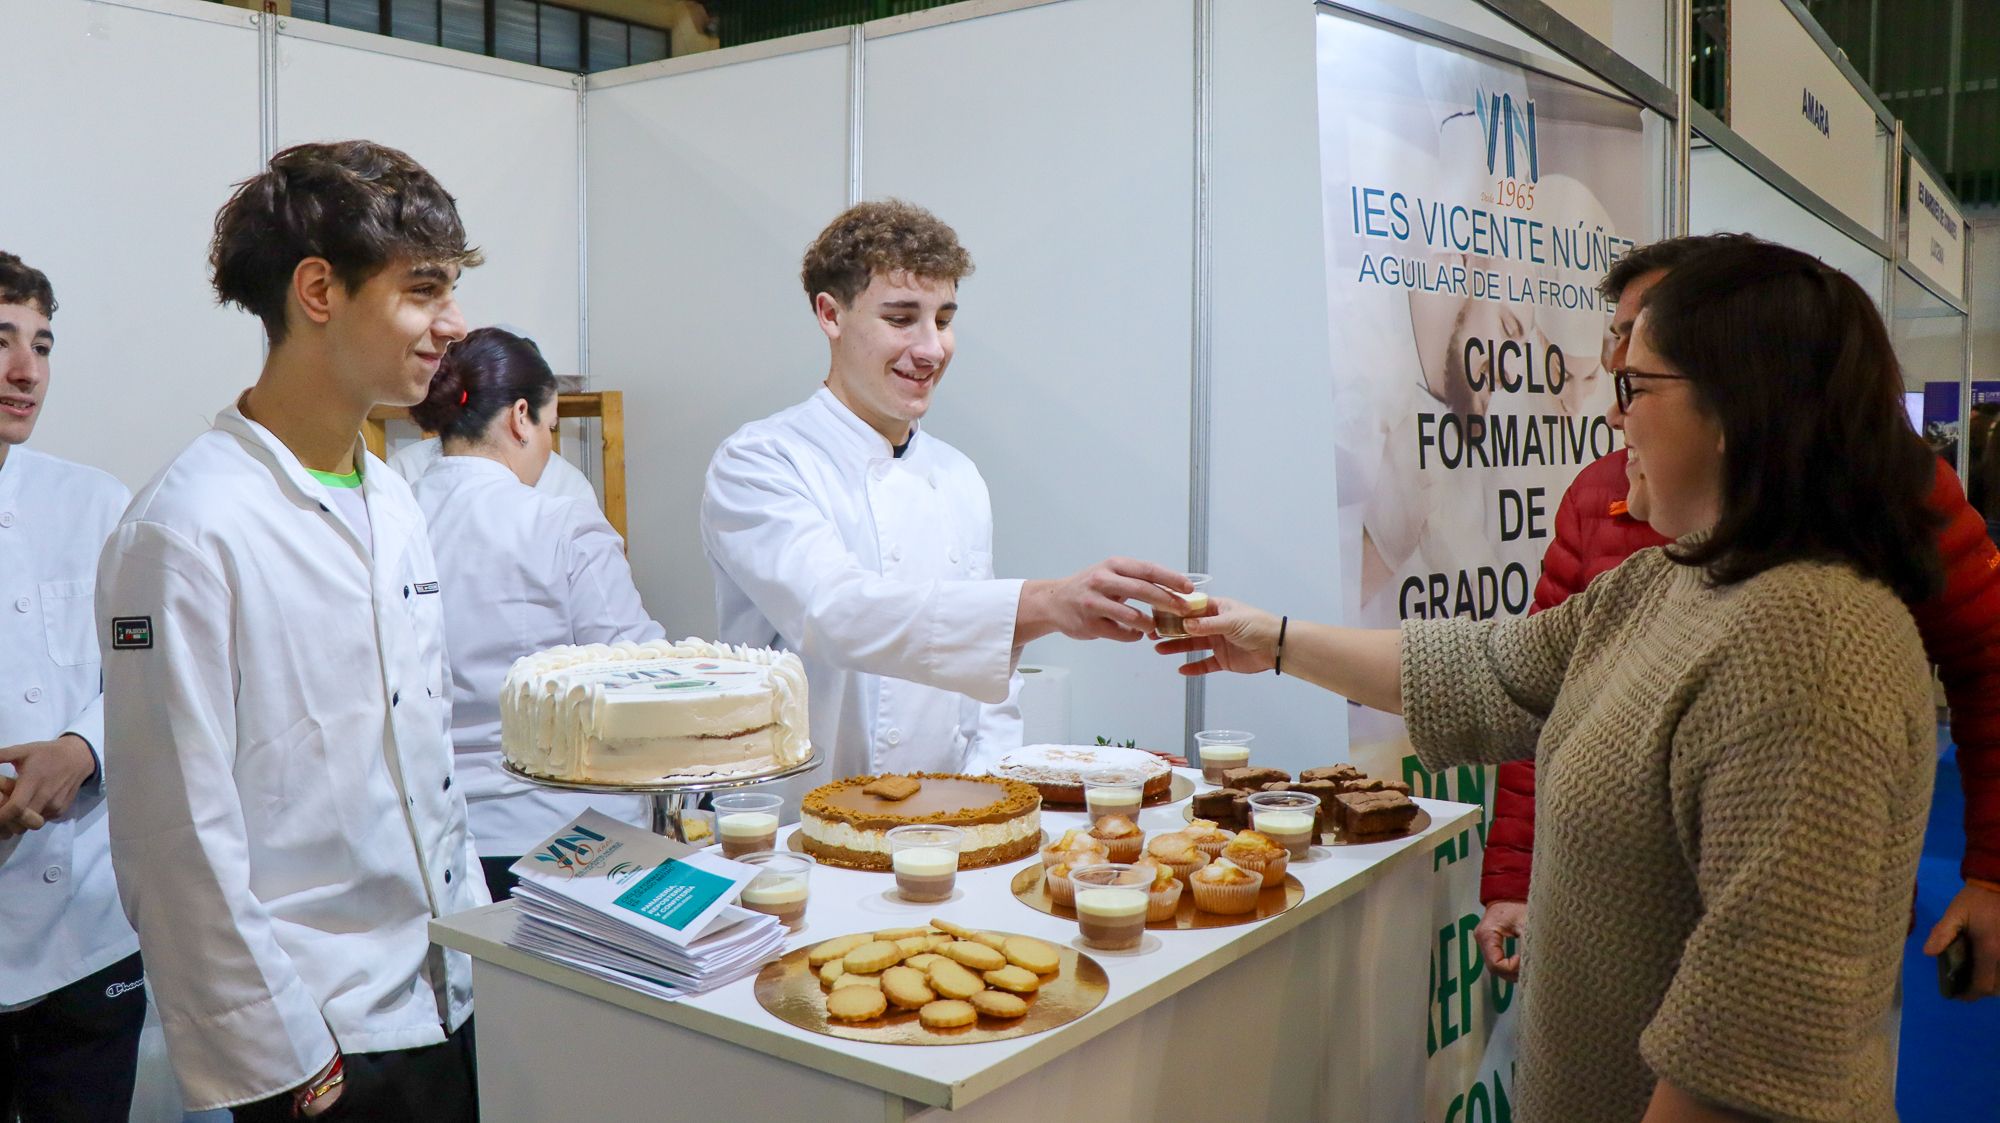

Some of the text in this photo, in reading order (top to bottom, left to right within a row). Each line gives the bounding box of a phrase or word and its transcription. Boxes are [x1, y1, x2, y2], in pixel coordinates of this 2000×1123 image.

[1802, 87, 1830, 139] AMARA
[1496, 179, 1535, 211] 1965
[1351, 186, 1410, 241] IES
[1417, 198, 1546, 265] VICENTE
[1358, 253, 1468, 296] AGUILAR
[1473, 270, 1501, 301] DE
[1508, 275, 1535, 304] LA
[1464, 336, 1566, 396] CICLO
[1417, 412, 1614, 470] FORMATIVO
[1498, 487, 1547, 542] DE
[1399, 561, 1529, 622] GRADO
[647, 885, 686, 915] REPOSTERÍA
